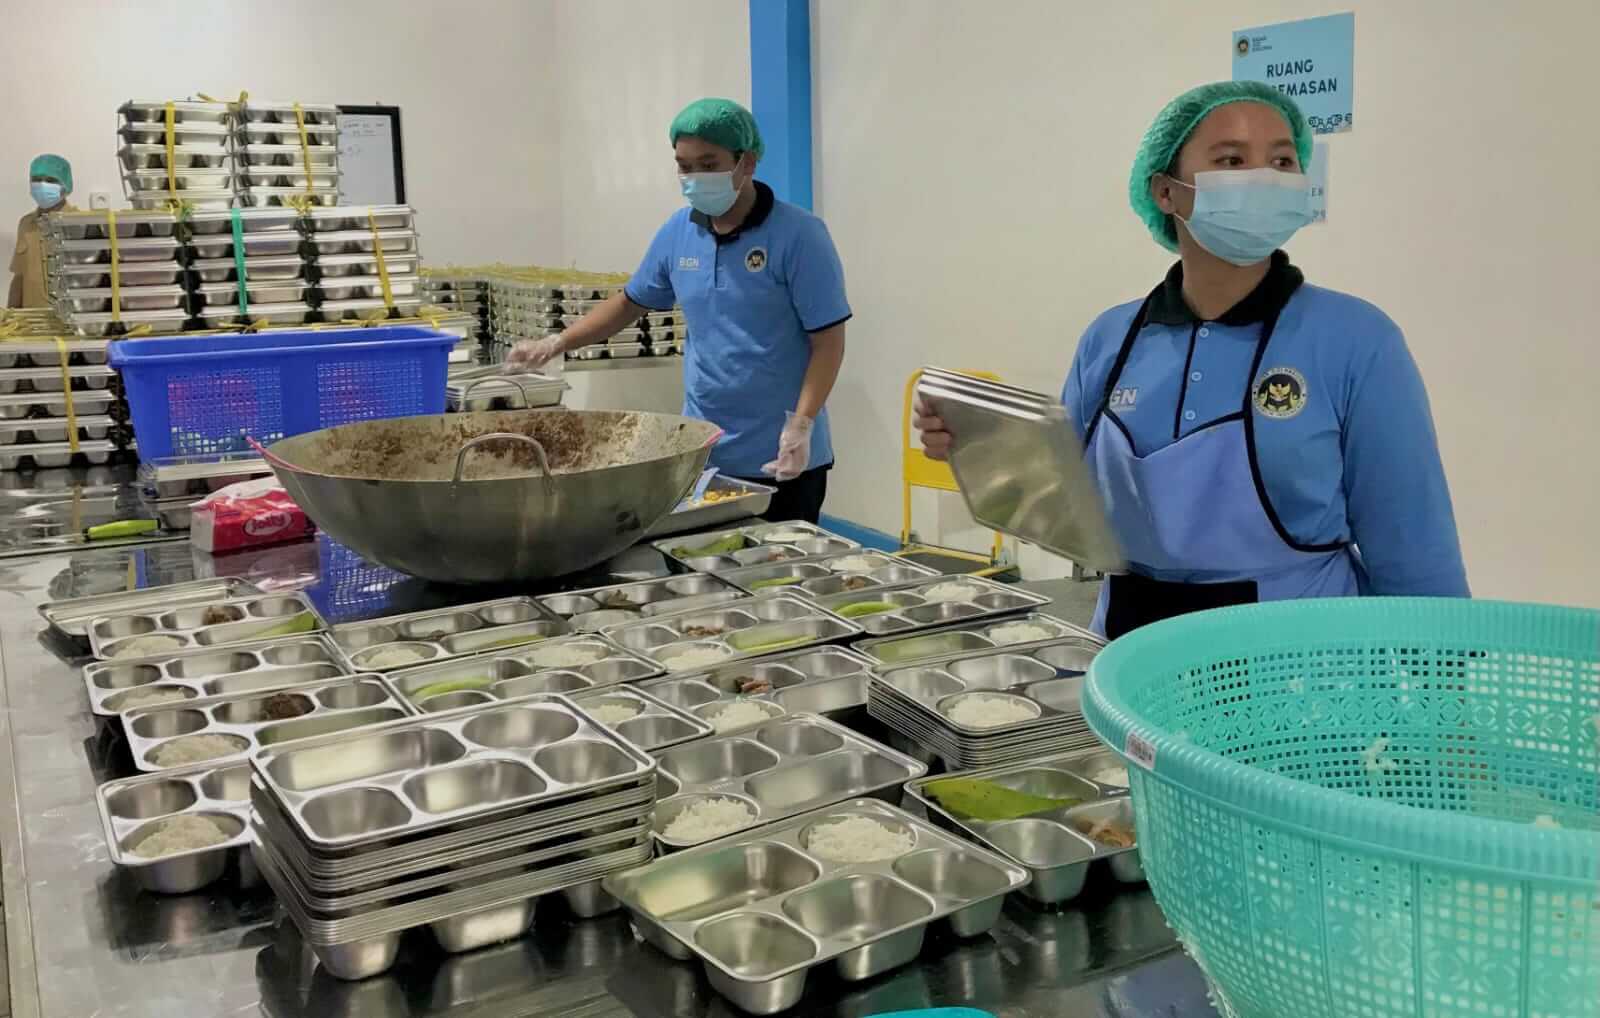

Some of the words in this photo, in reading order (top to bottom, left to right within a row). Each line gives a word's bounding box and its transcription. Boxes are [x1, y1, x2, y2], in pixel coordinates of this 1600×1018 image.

[1266, 59, 1314, 78] RUANG
[1272, 78, 1337, 96] EMASAN
[1109, 388, 1137, 407] GN
